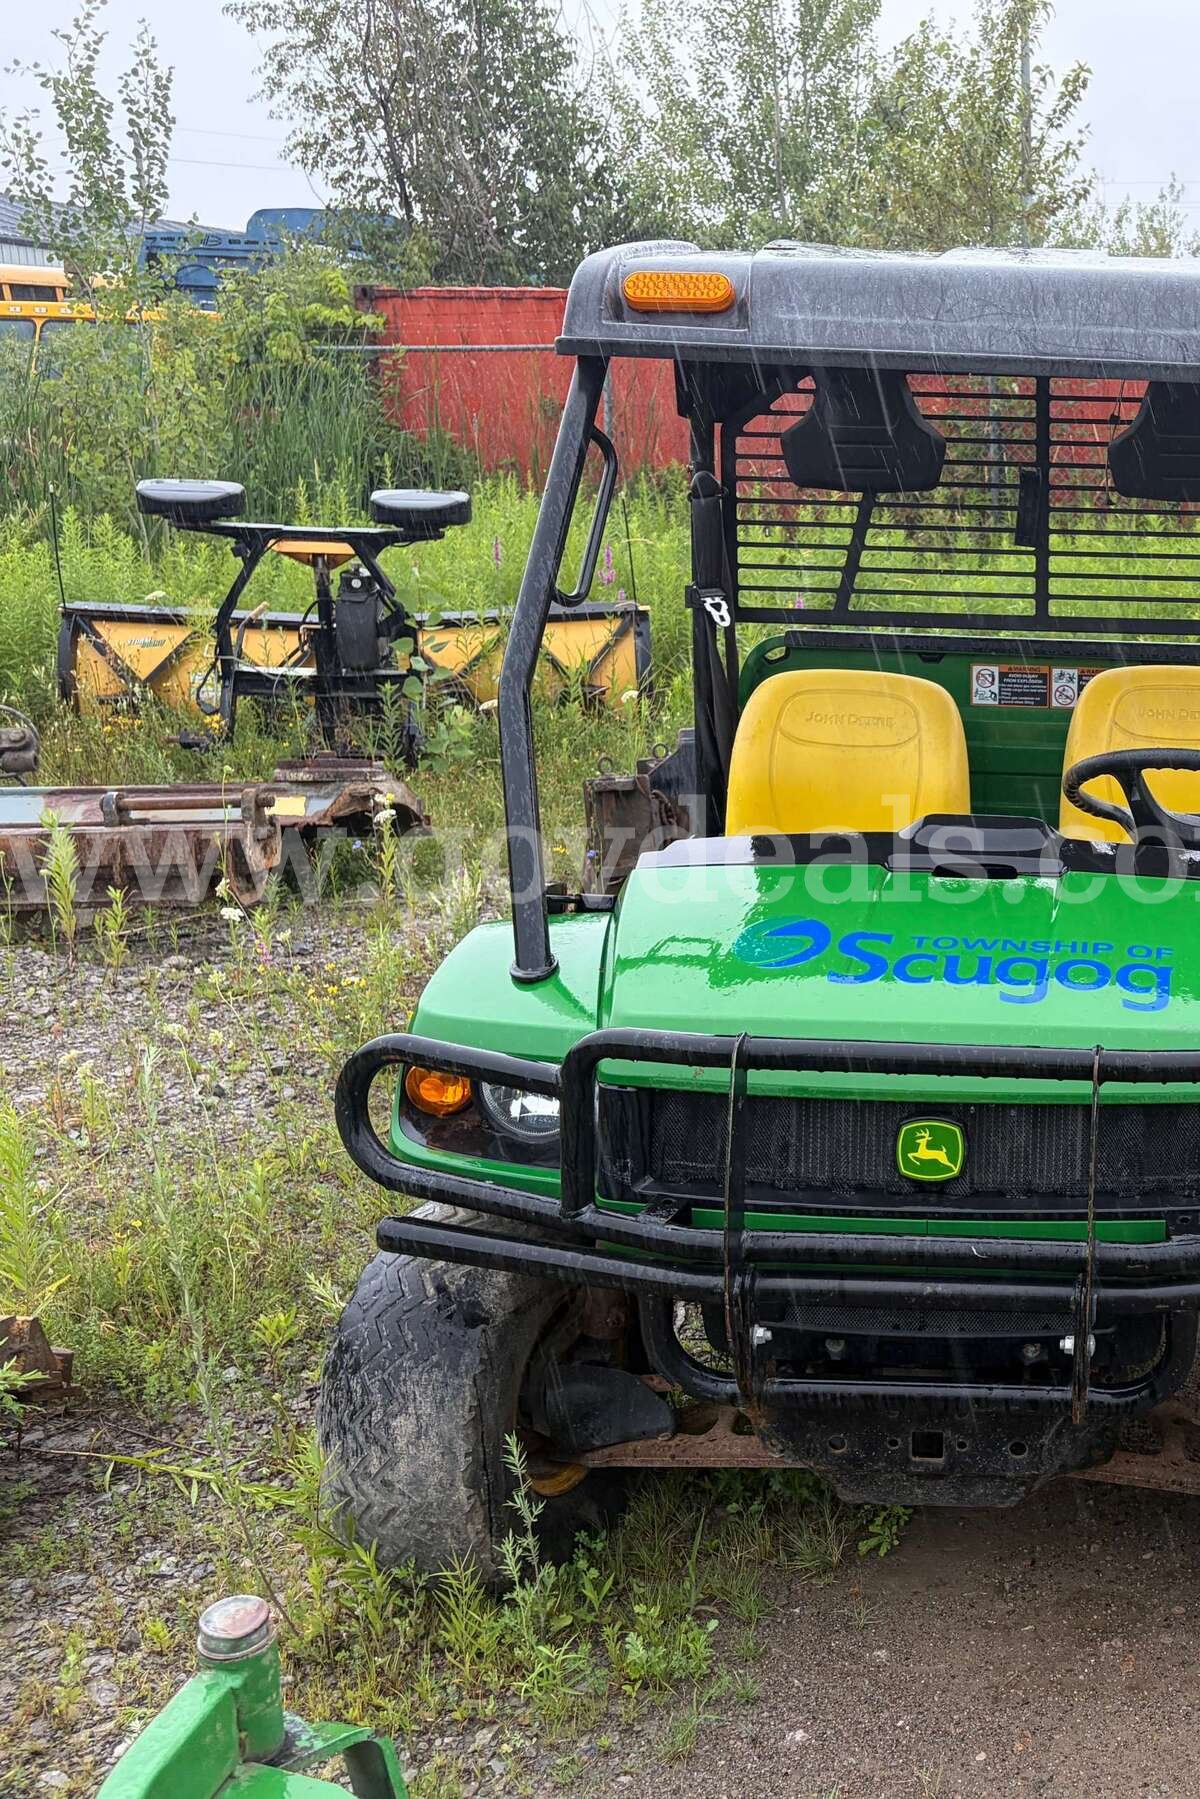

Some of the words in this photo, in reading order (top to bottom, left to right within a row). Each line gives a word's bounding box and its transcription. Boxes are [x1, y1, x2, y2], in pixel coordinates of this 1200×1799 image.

[805, 711, 846, 725] JOHN
[847, 713, 897, 729] DEERE
[1142, 708, 1178, 721] JOHN
[911, 935, 1115, 953] TOWNSHIP
[1127, 944, 1175, 961] OF
[827, 931, 1174, 1012] Scugog
